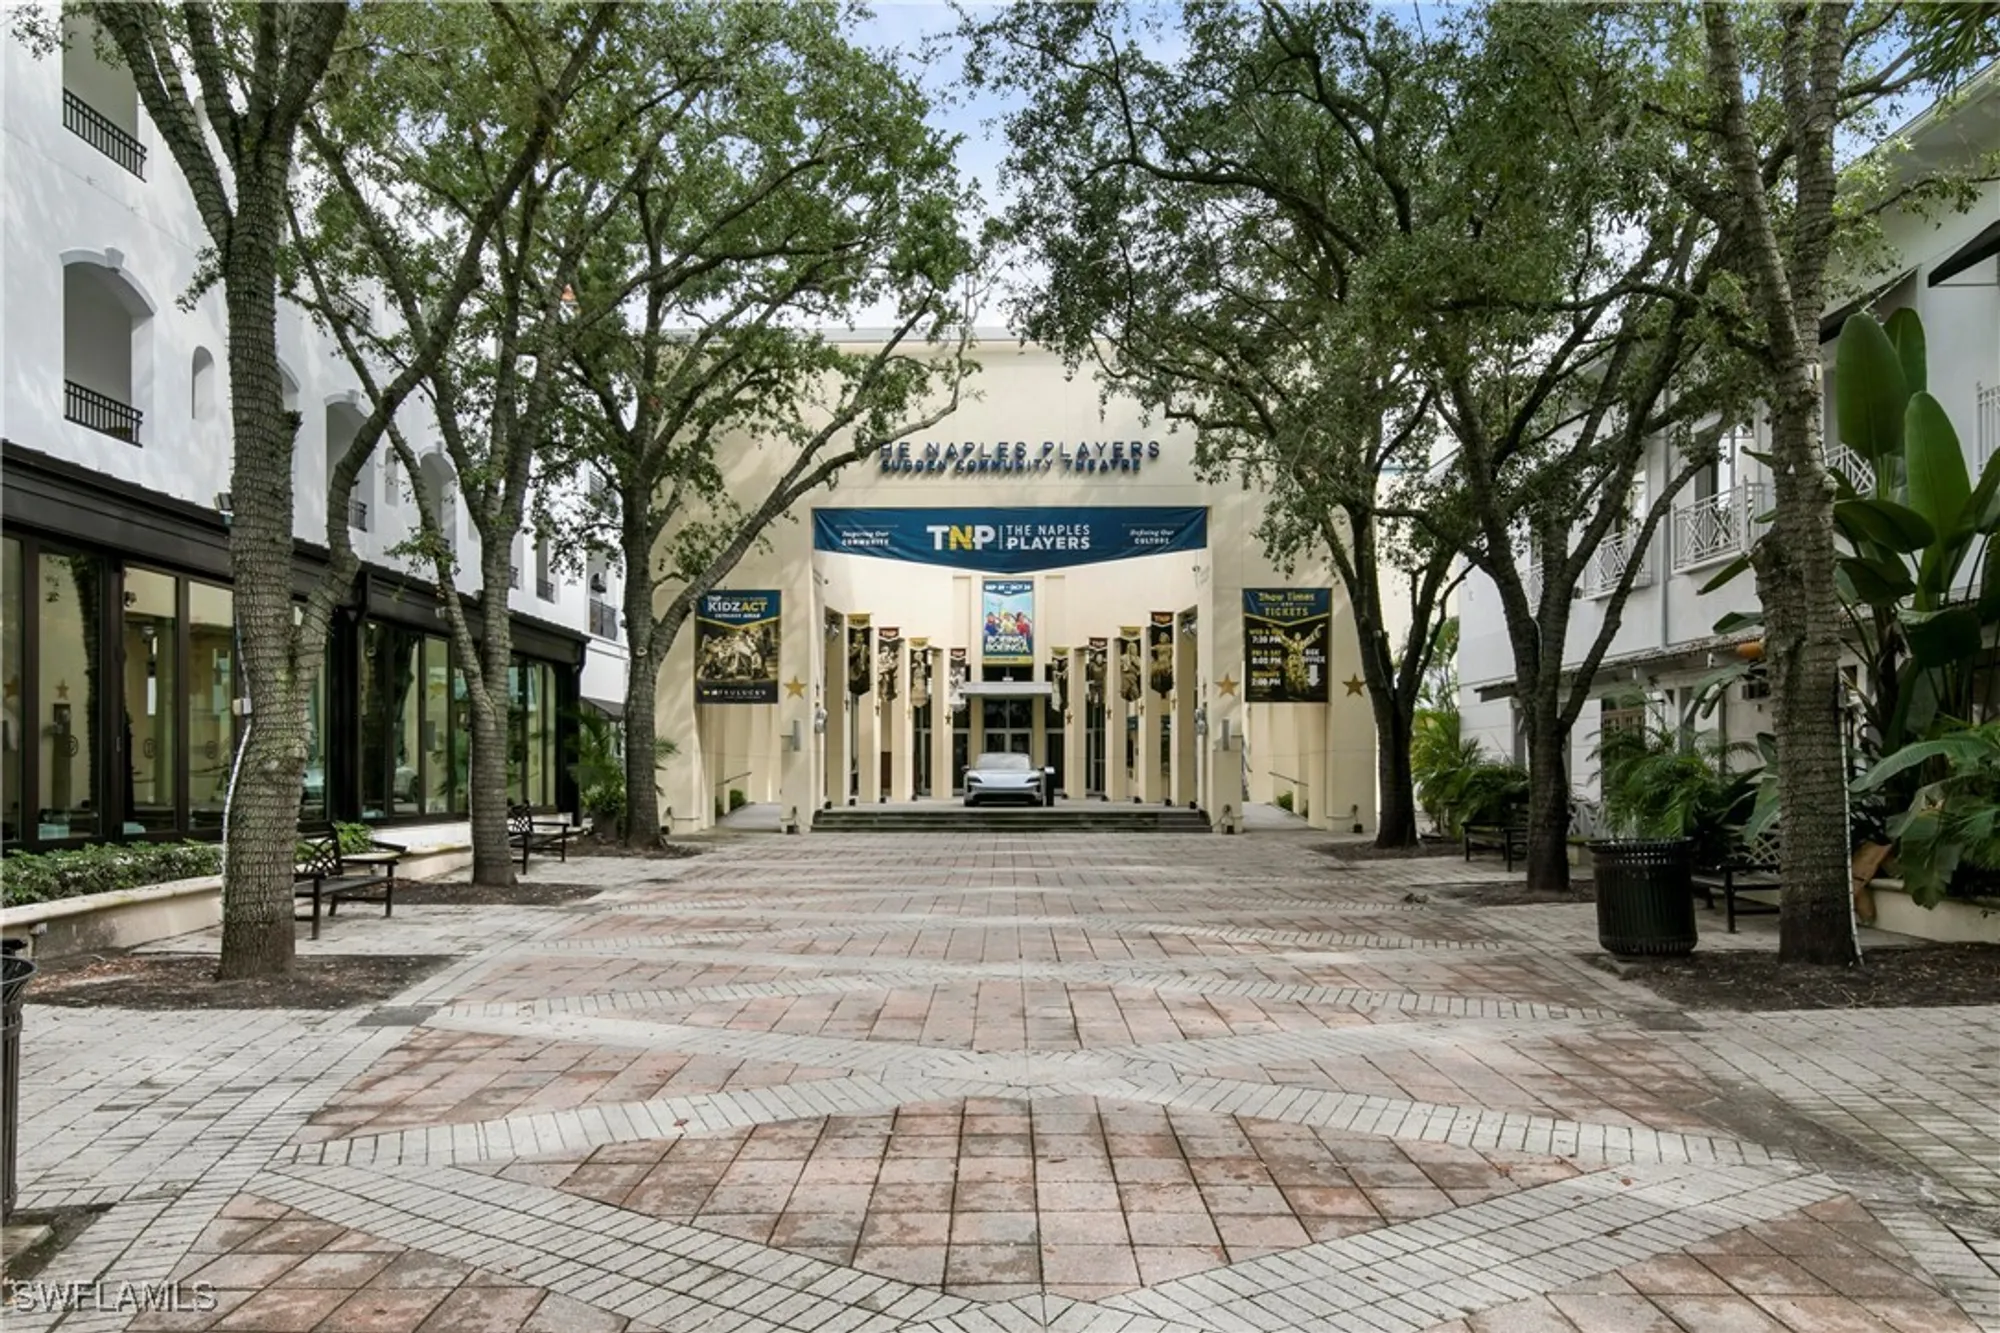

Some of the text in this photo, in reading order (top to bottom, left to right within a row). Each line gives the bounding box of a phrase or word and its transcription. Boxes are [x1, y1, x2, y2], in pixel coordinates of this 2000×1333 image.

[880, 441, 1161, 460] HE NAPLES PLAYERS
[954, 458, 1053, 473] COMMUNITY
[1063, 458, 1142, 473] THEATRE
[1006, 524, 1091, 536] THE NAPLES
[926, 524, 996, 550] TNP
[1006, 537, 1091, 550] PLAYERS
[707, 601, 768, 612] KIDZACT
[1264, 607, 1309, 617] TICKETS
